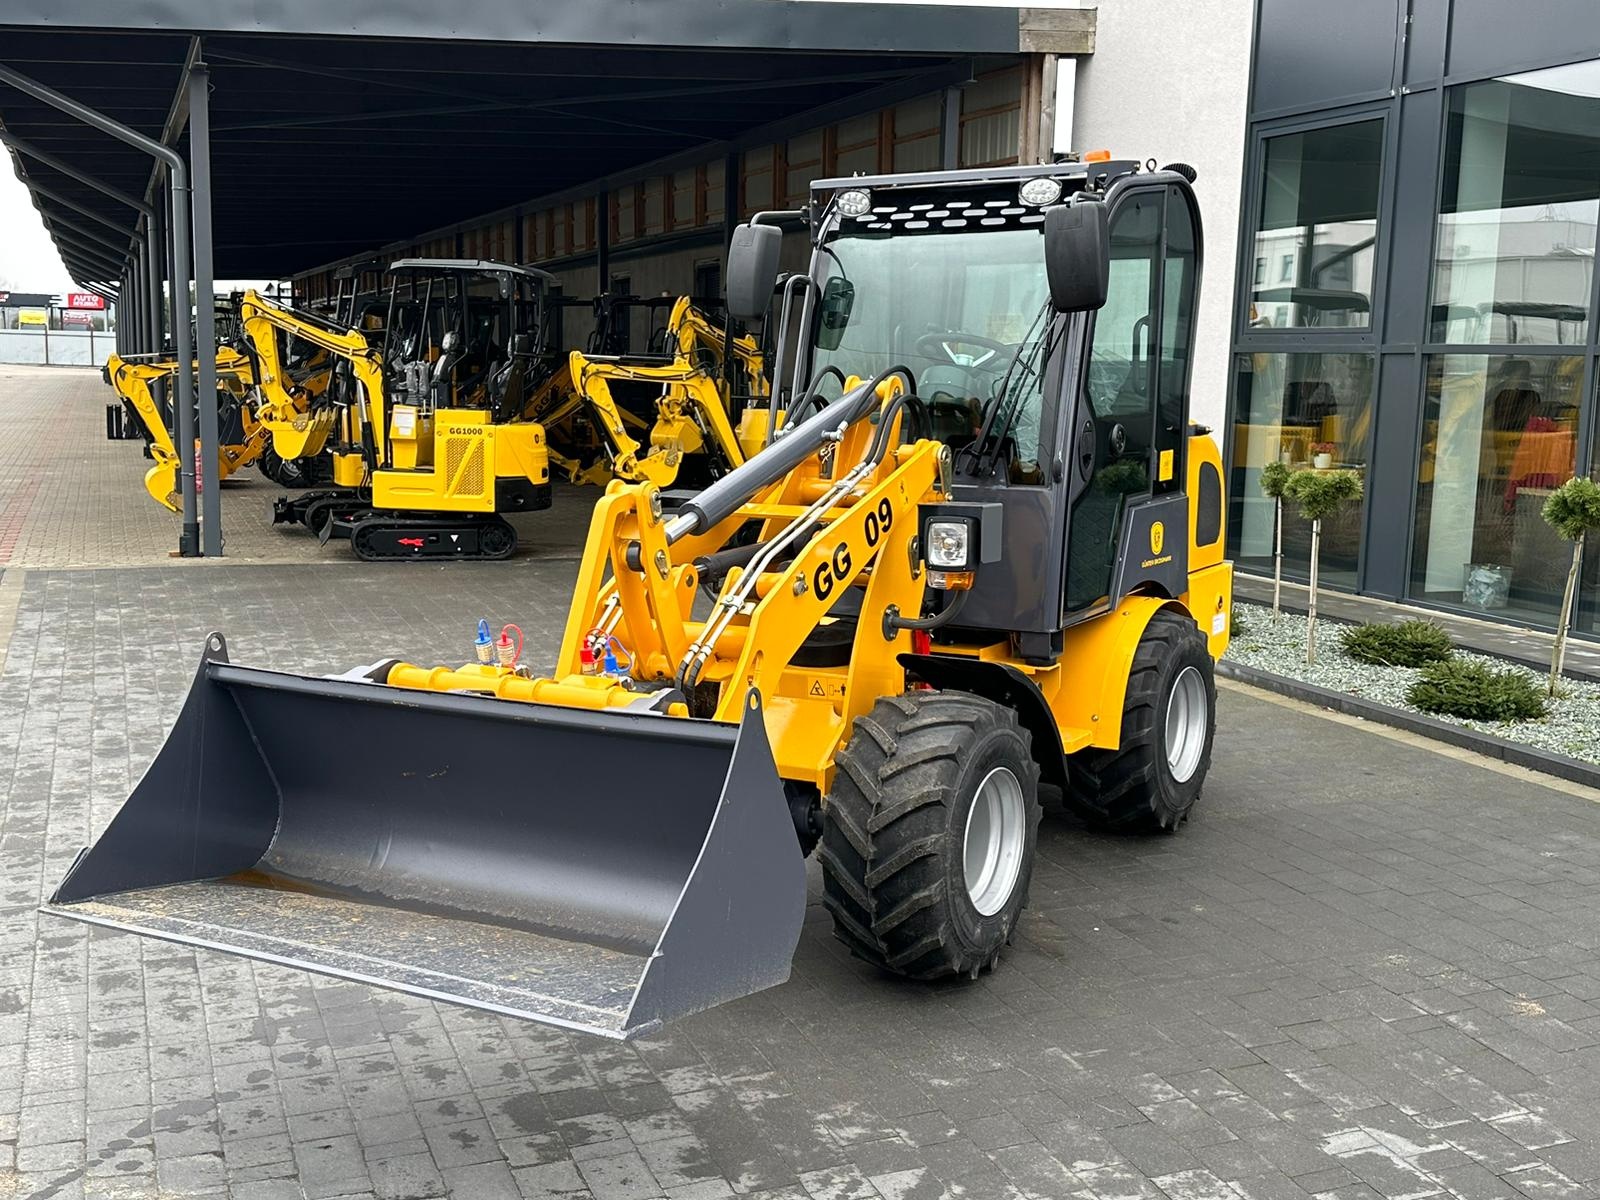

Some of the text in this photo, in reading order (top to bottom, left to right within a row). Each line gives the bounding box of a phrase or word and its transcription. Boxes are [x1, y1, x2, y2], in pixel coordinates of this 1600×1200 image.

[73, 294, 99, 302] AUTO
[449, 427, 483, 435] GG1000
[813, 497, 893, 601] GG 09
